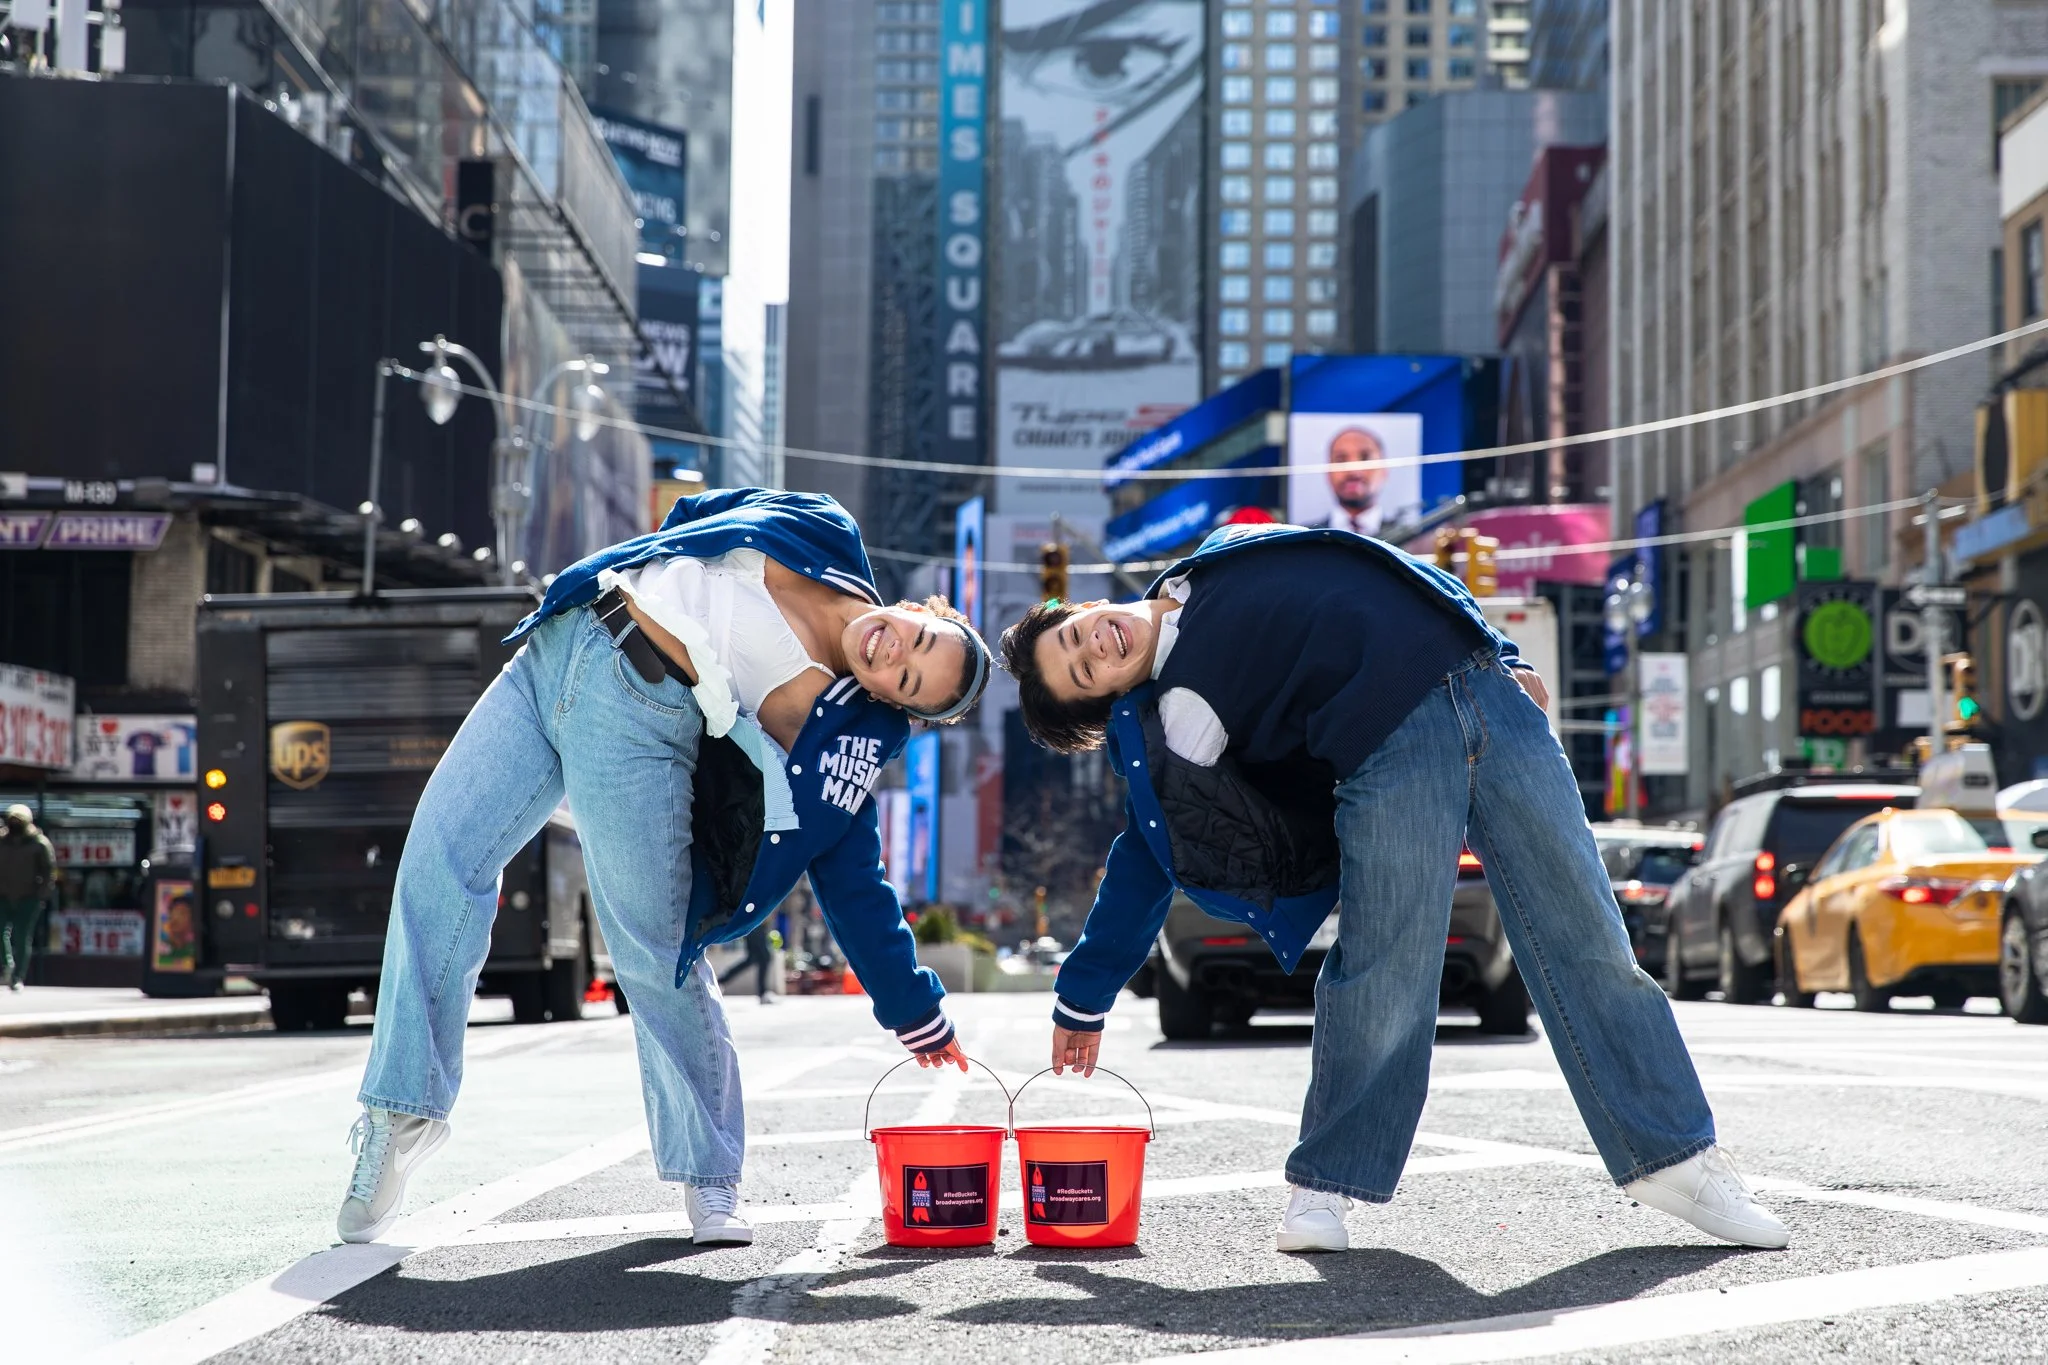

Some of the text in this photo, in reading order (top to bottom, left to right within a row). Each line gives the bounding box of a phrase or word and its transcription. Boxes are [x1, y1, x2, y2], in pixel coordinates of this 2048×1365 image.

[945, 189, 982, 439] SQUARE
[60, 516, 151, 542] PRIME
[276, 741, 326, 780] ups
[837, 735, 882, 764] THE
[821, 775, 868, 816] MAN
[935, 1198, 984, 1207] broadwaycares.org
[943, 1191, 978, 1199] #RedBuckets
[1049, 1195, 1102, 1204] broadwaycares.org
